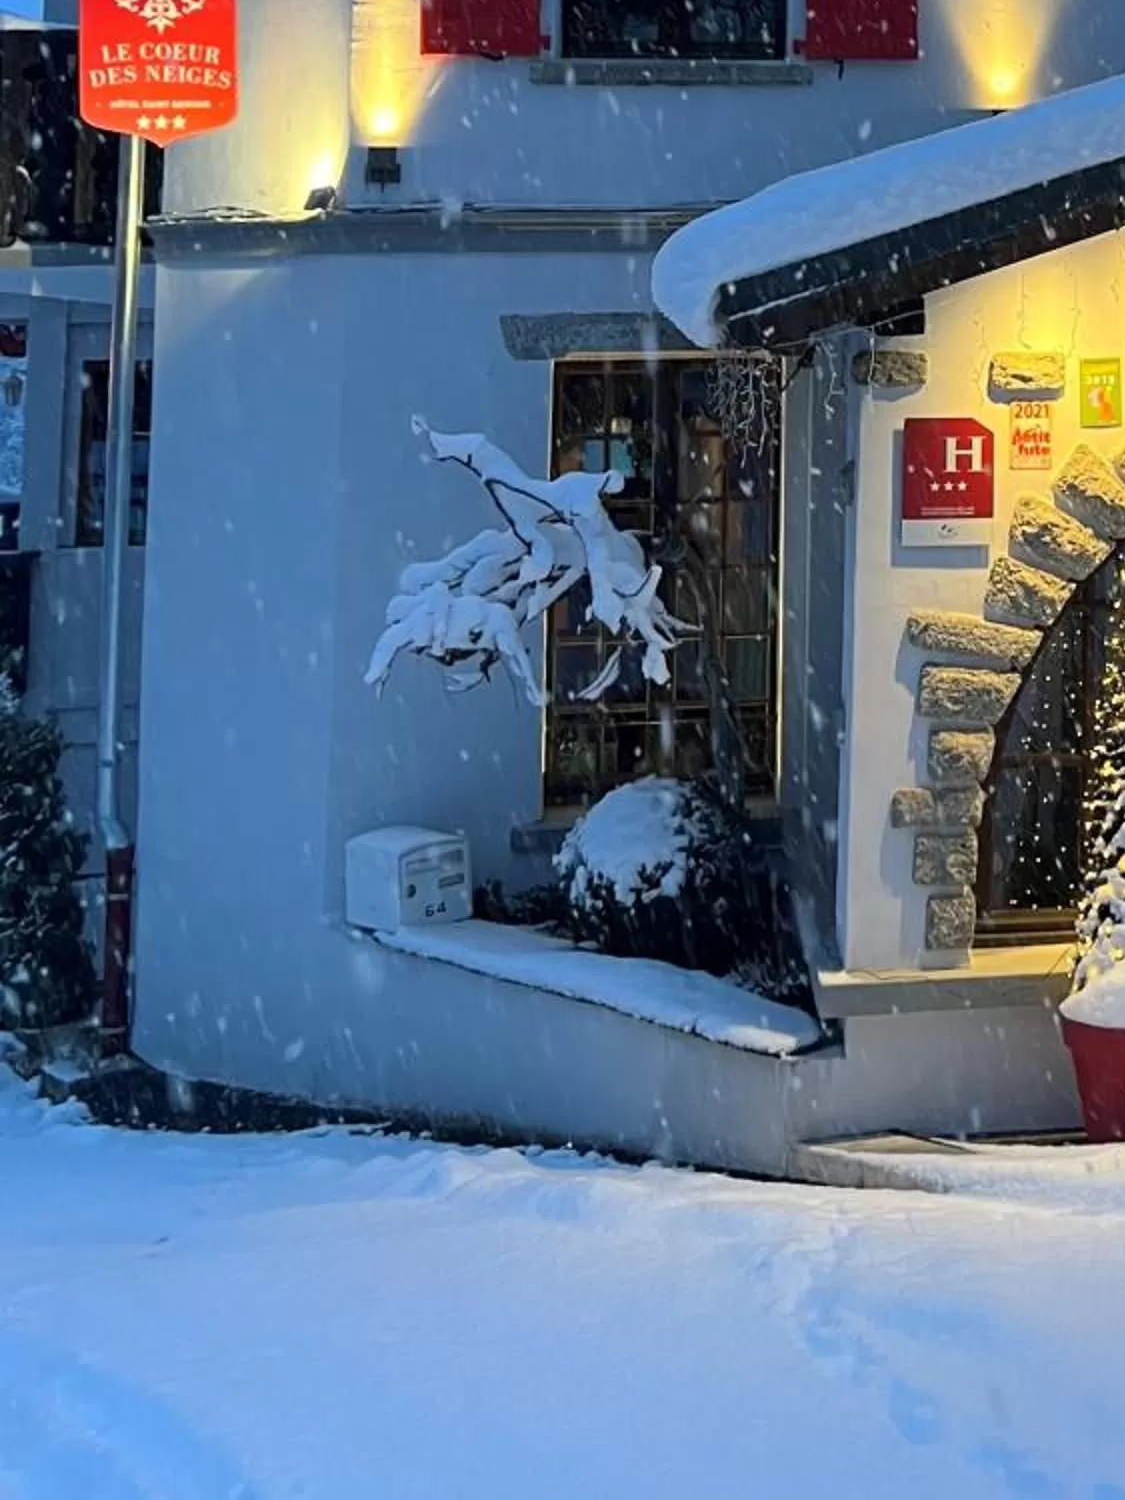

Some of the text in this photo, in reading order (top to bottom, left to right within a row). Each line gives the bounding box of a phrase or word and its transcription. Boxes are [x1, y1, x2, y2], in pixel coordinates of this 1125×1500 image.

[101, 43, 221, 65] LE COEUR
[89, 65, 232, 89] DES NEIGES
[1015, 403, 1049, 418] 2021
[943, 435, 987, 474] H
[425, 900, 447, 917] 64
